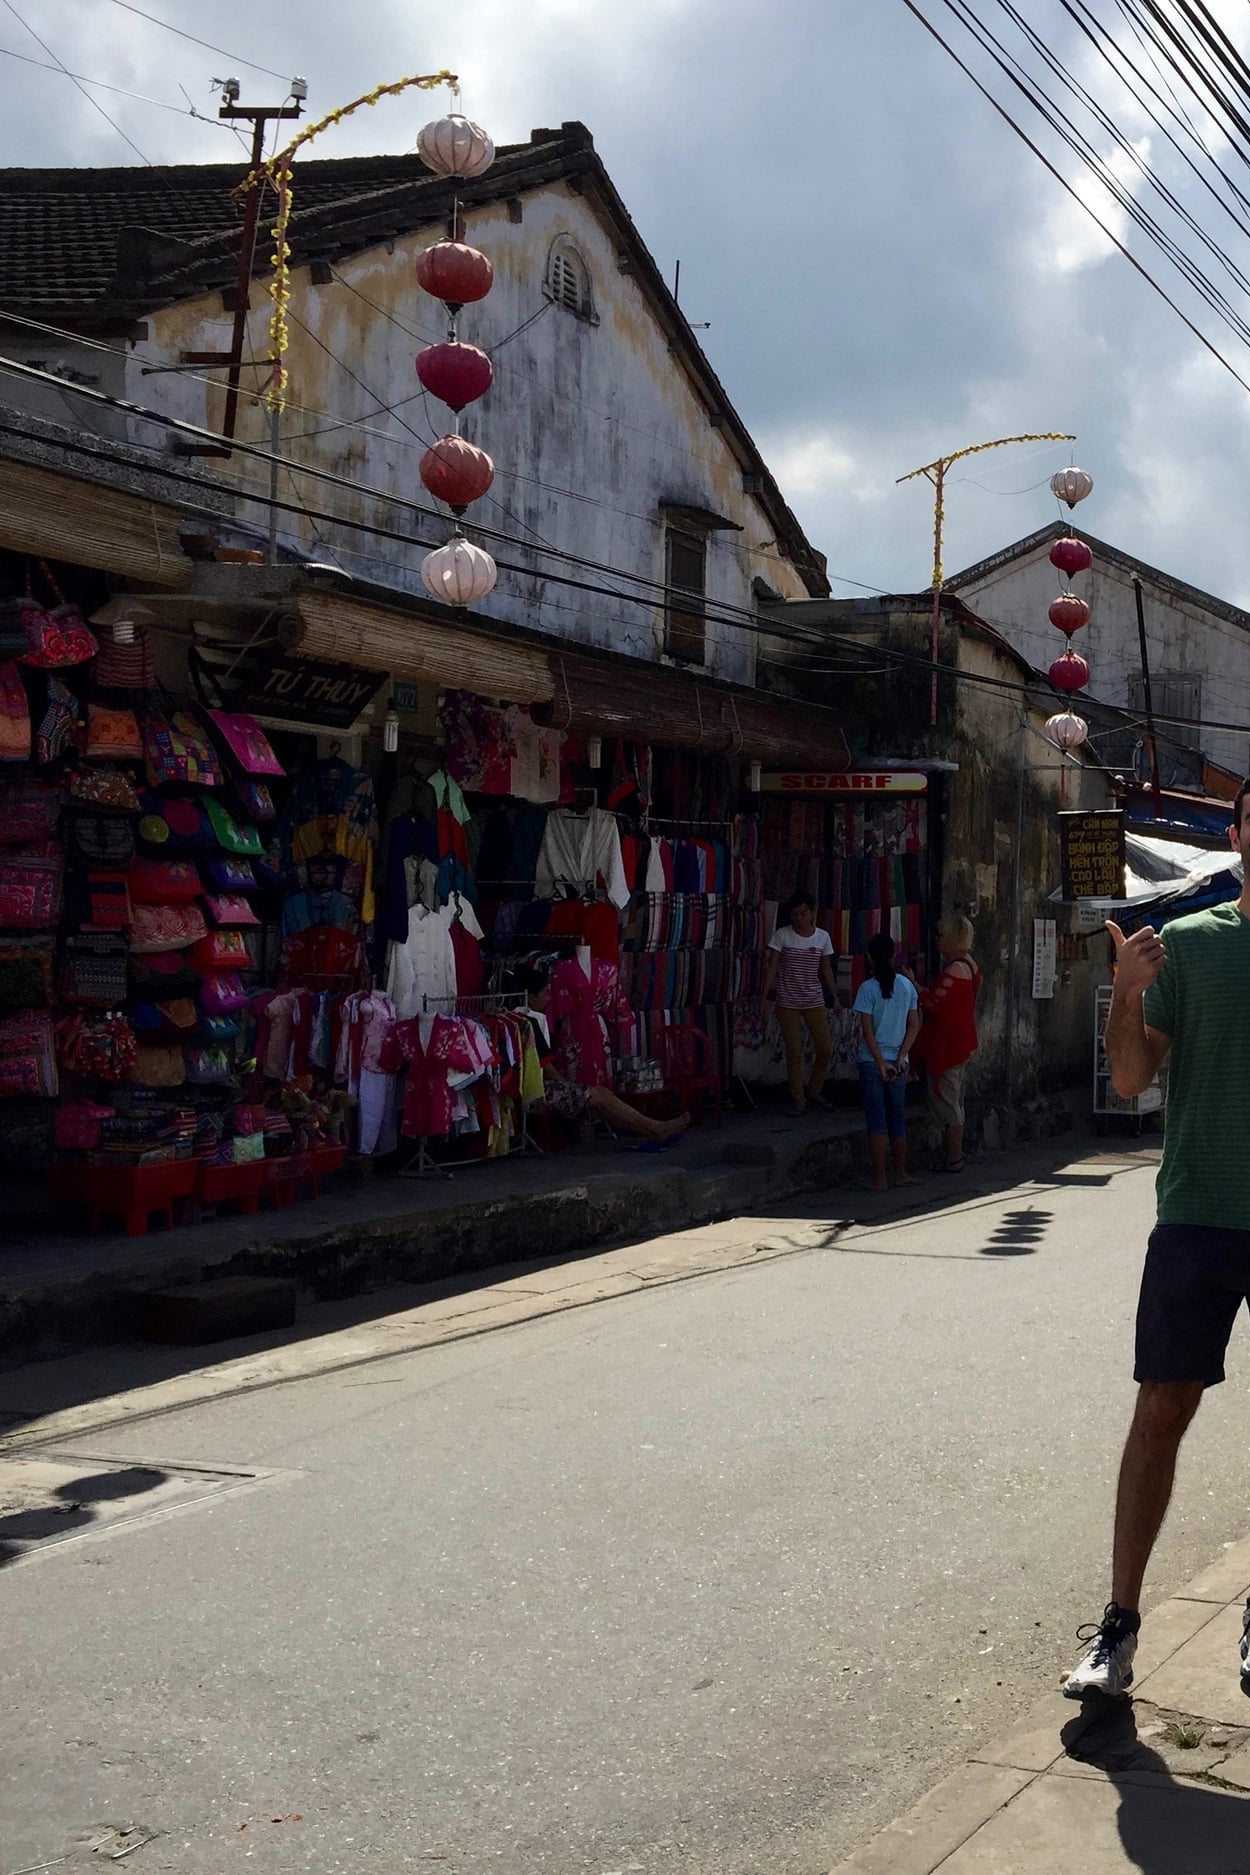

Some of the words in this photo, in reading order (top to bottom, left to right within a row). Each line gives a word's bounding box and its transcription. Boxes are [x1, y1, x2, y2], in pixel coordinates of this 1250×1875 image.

[263, 665, 307, 694] TÚ
[780, 775, 893, 788] SCARF
[1071, 870, 1092, 882] CAO
